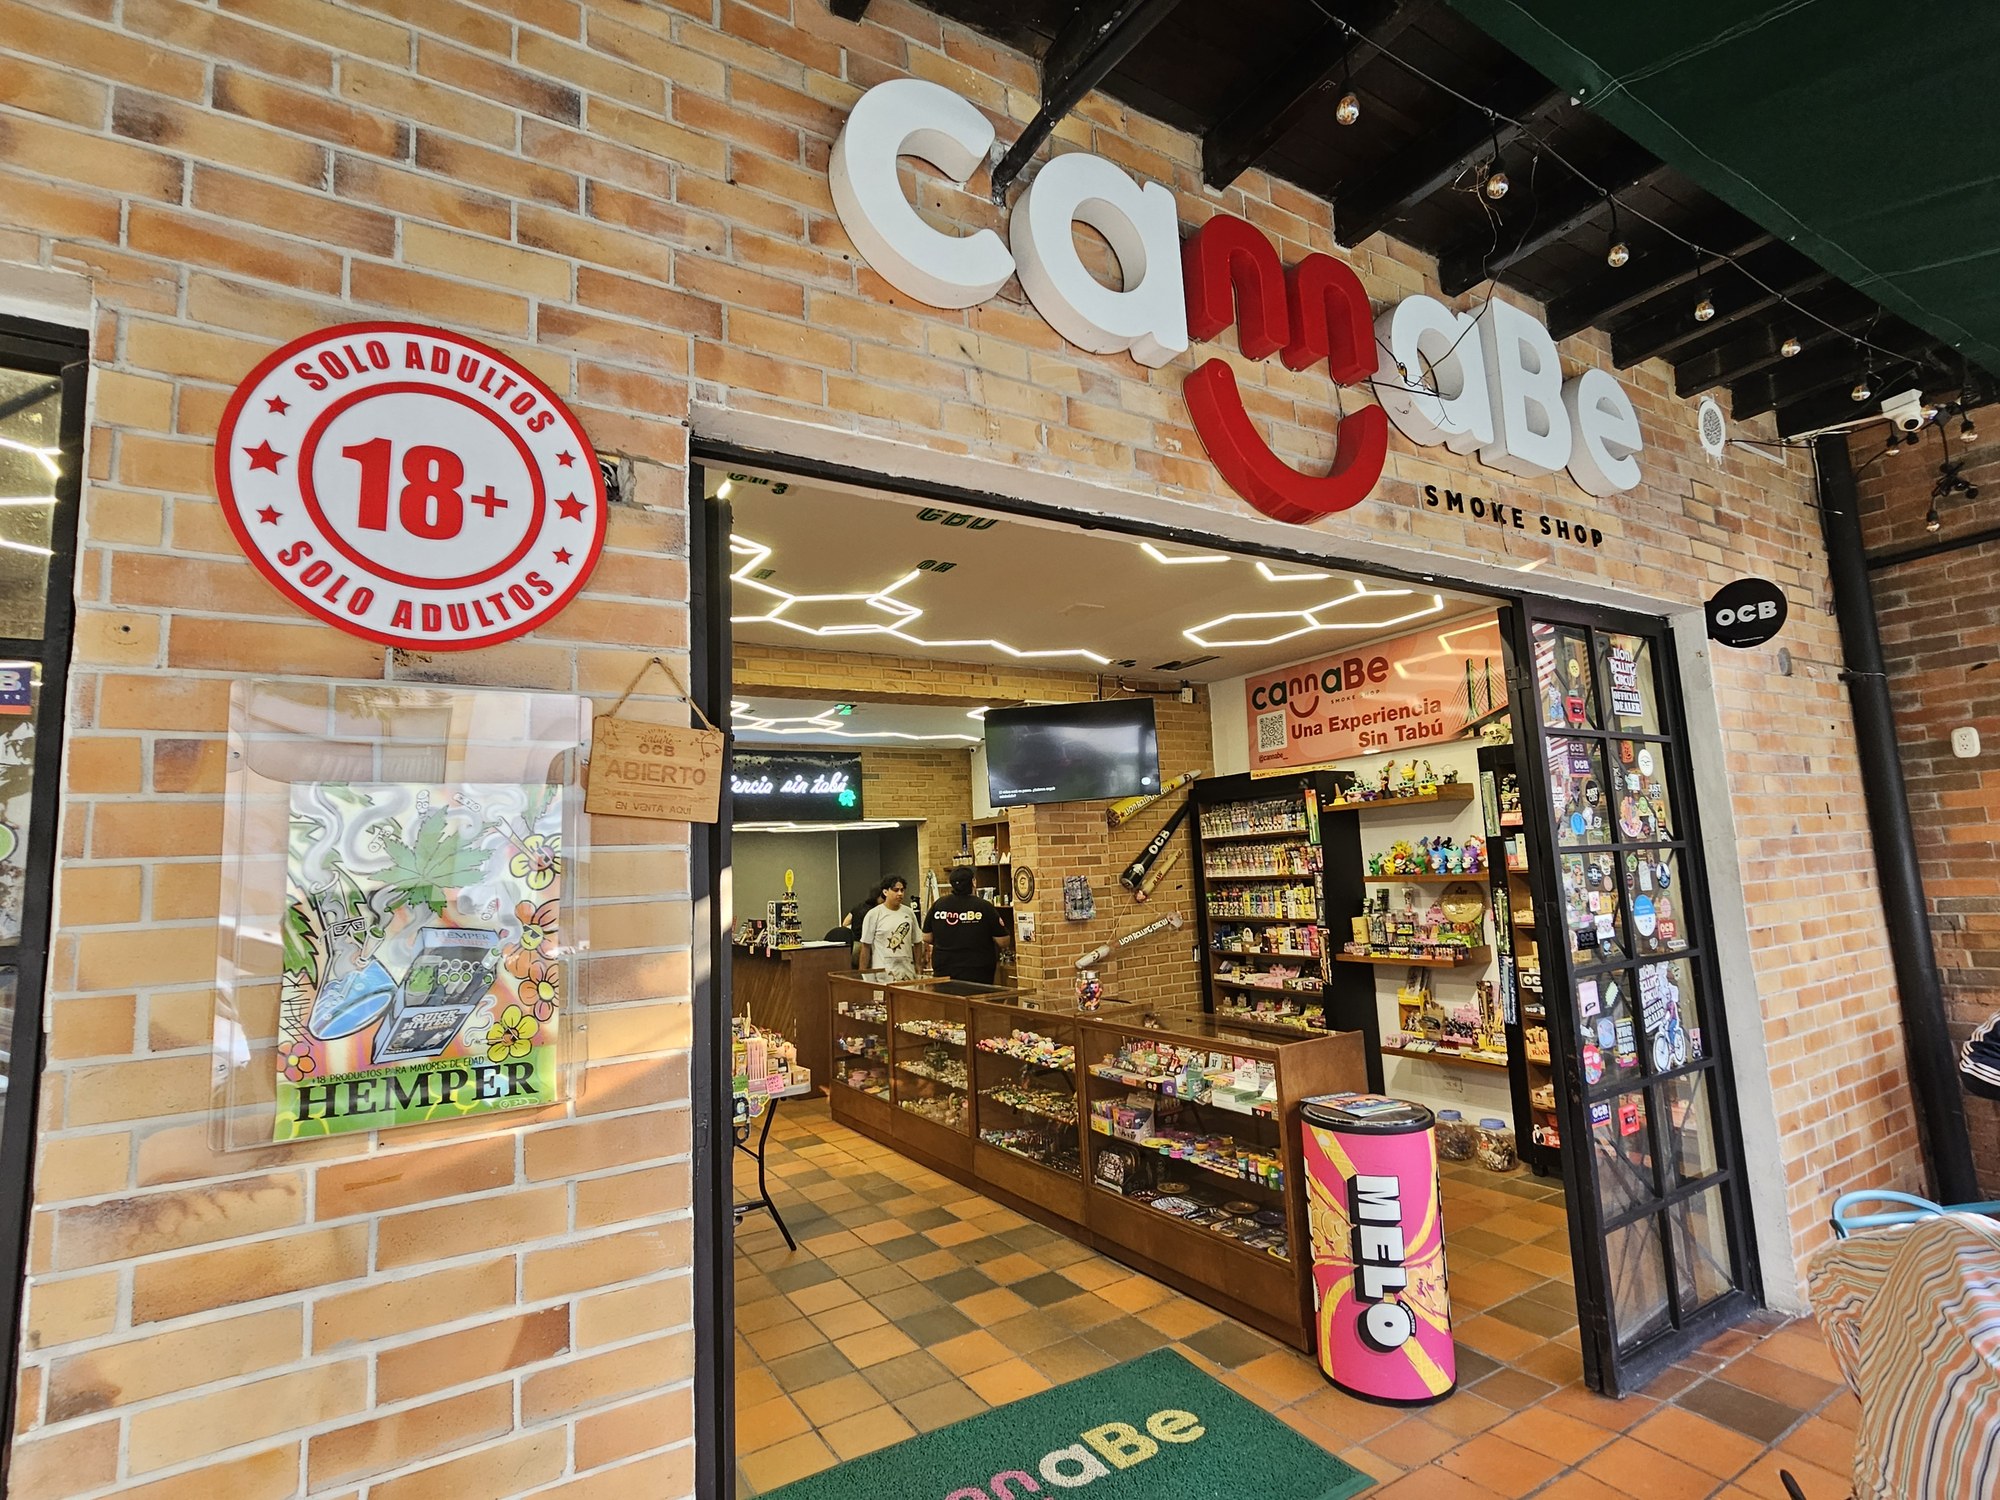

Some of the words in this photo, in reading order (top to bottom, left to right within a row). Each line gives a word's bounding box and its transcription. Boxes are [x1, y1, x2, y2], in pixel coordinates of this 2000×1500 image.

[828, 78, 1644, 500] cannaBe
[294, 340, 391, 392] SOLO
[405, 341, 555, 433] ADULTOS
[342, 437, 508, 540] 18+
[1425, 485, 1525, 529] SMOKE
[1539, 516, 1603, 547] SHOP
[278, 540, 375, 616] SOLO
[390, 571, 554, 633] ADULTOS
[1715, 600, 1778, 626] OCB
[1252, 656, 1390, 711] cannaBe
[1330, 695, 1356, 704] SMOKE
[1291, 723, 1323, 741] Una
[1328, 698, 1442, 732] Experiencia
[1358, 728, 1388, 749] Sin
[1394, 719, 1444, 744] Tabú
[639, 743, 675, 757] OCB
[605, 760, 706, 785] ABIERTO
[1574, 760, 1589, 770] OCB
[780, 775, 810, 794] sin
[810, 771, 849, 794] tabú
[615, 802, 627, 810] EN
[634, 803, 664, 812] VENTA
[1149, 830, 1170, 855] OCB
[934, 911, 982, 920] cannaBe
[1523, 975, 1541, 986] OC
[411, 1010, 459, 1022] QUICK
[312, 1076, 326, 1084] +18
[329, 1070, 382, 1083] PRODUCTOS
[409, 1060, 447, 1073] MAYORES
[450, 1058, 461, 1067] DE
[463, 1055, 485, 1066] EDAD
[294, 1062, 540, 1122] HEMPER
[1591, 1106, 1609, 1118] OCB
[1348, 1174, 1411, 1351] MELO
